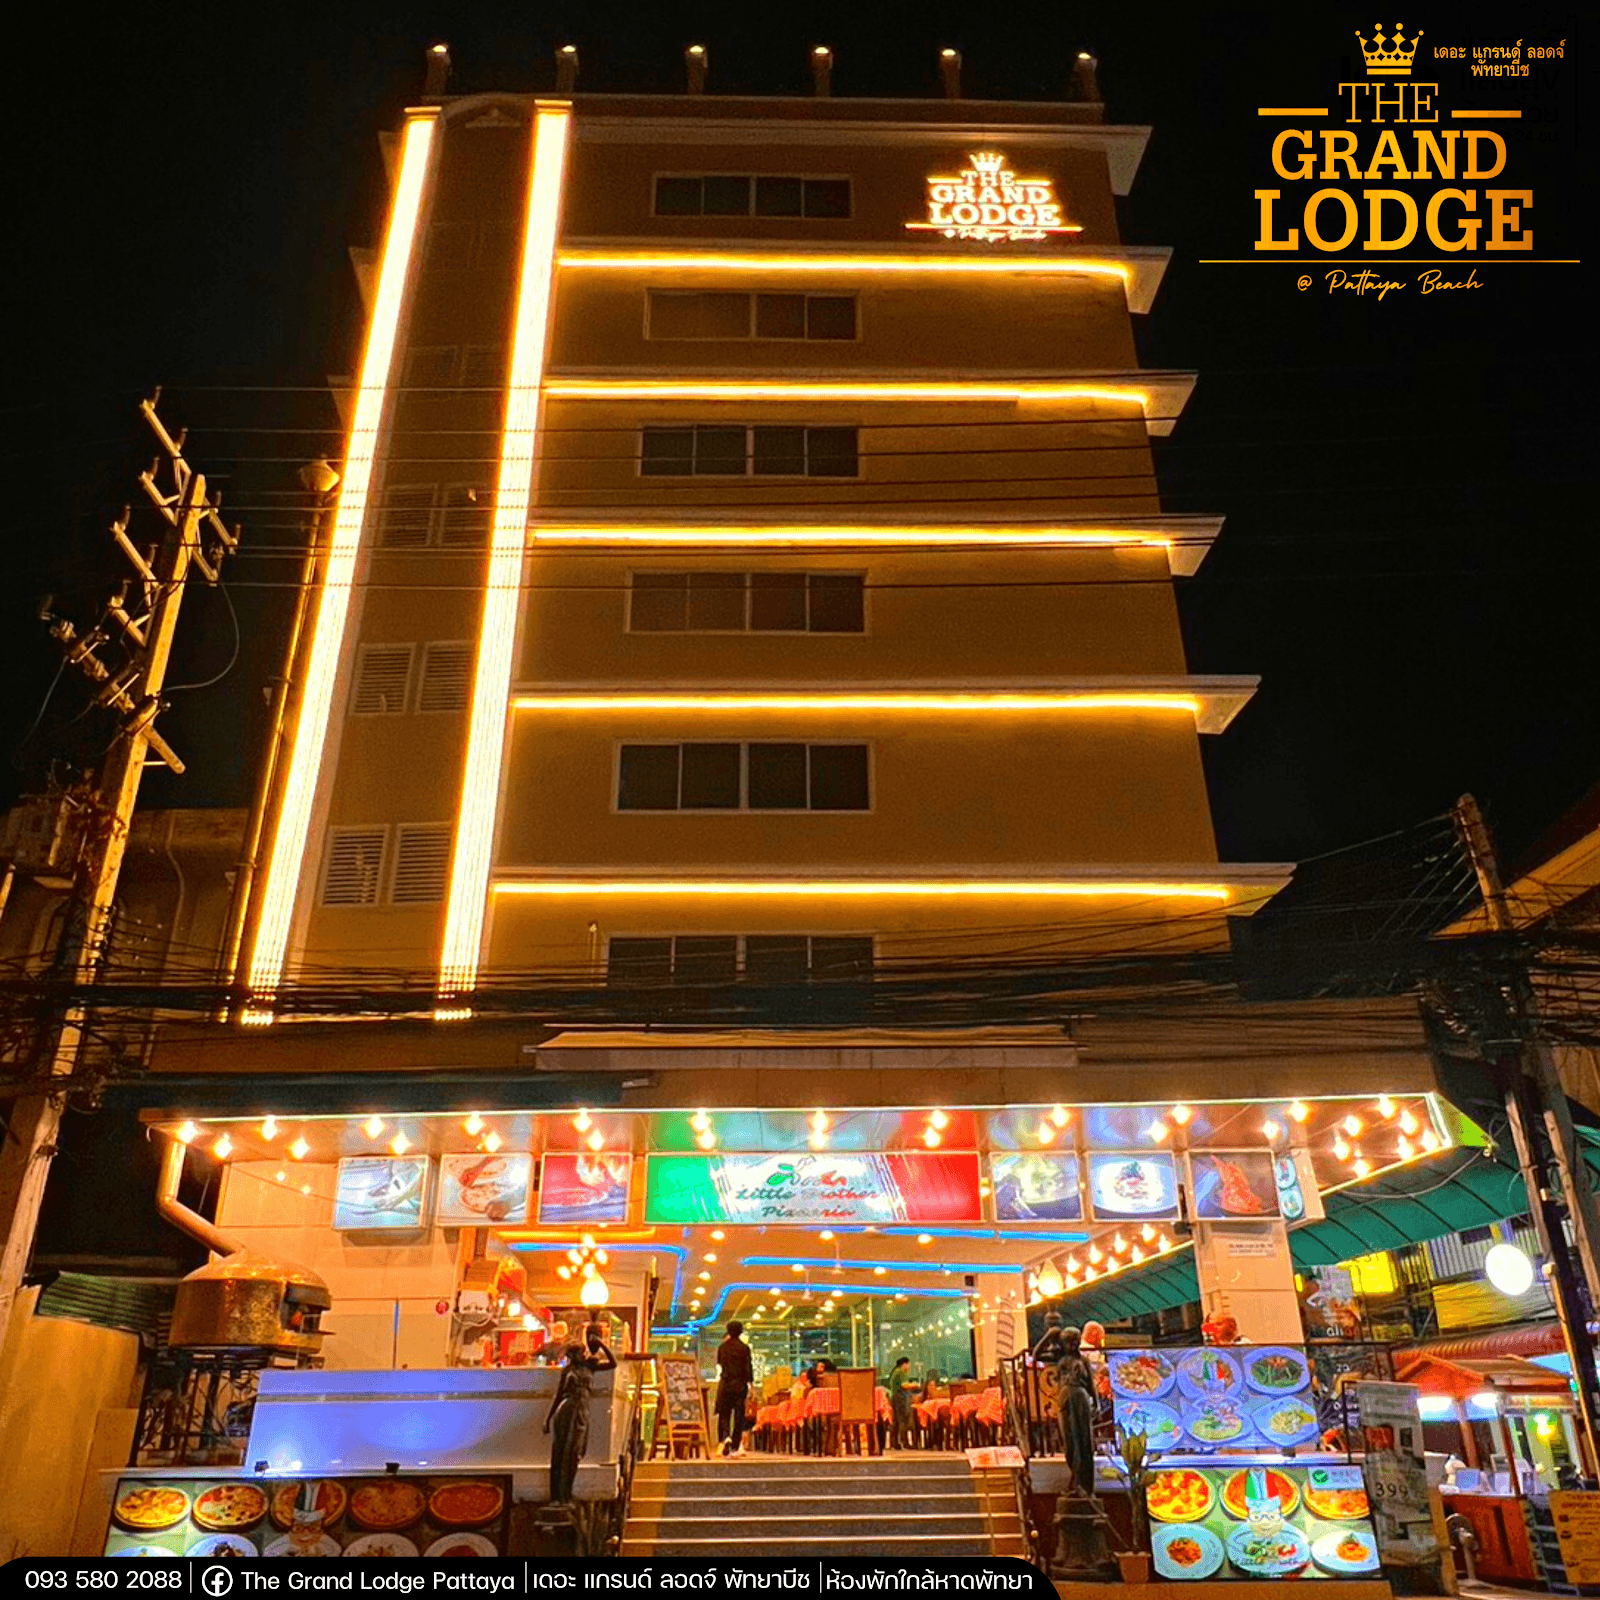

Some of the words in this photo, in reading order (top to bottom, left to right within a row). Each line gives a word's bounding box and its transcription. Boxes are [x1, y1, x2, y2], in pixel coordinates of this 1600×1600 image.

[961, 170, 1015, 187] THE
[930, 185, 1052, 204] GRAND
[929, 202, 1062, 226] LODGE
[1375, 1481, 1409, 1499] 399
